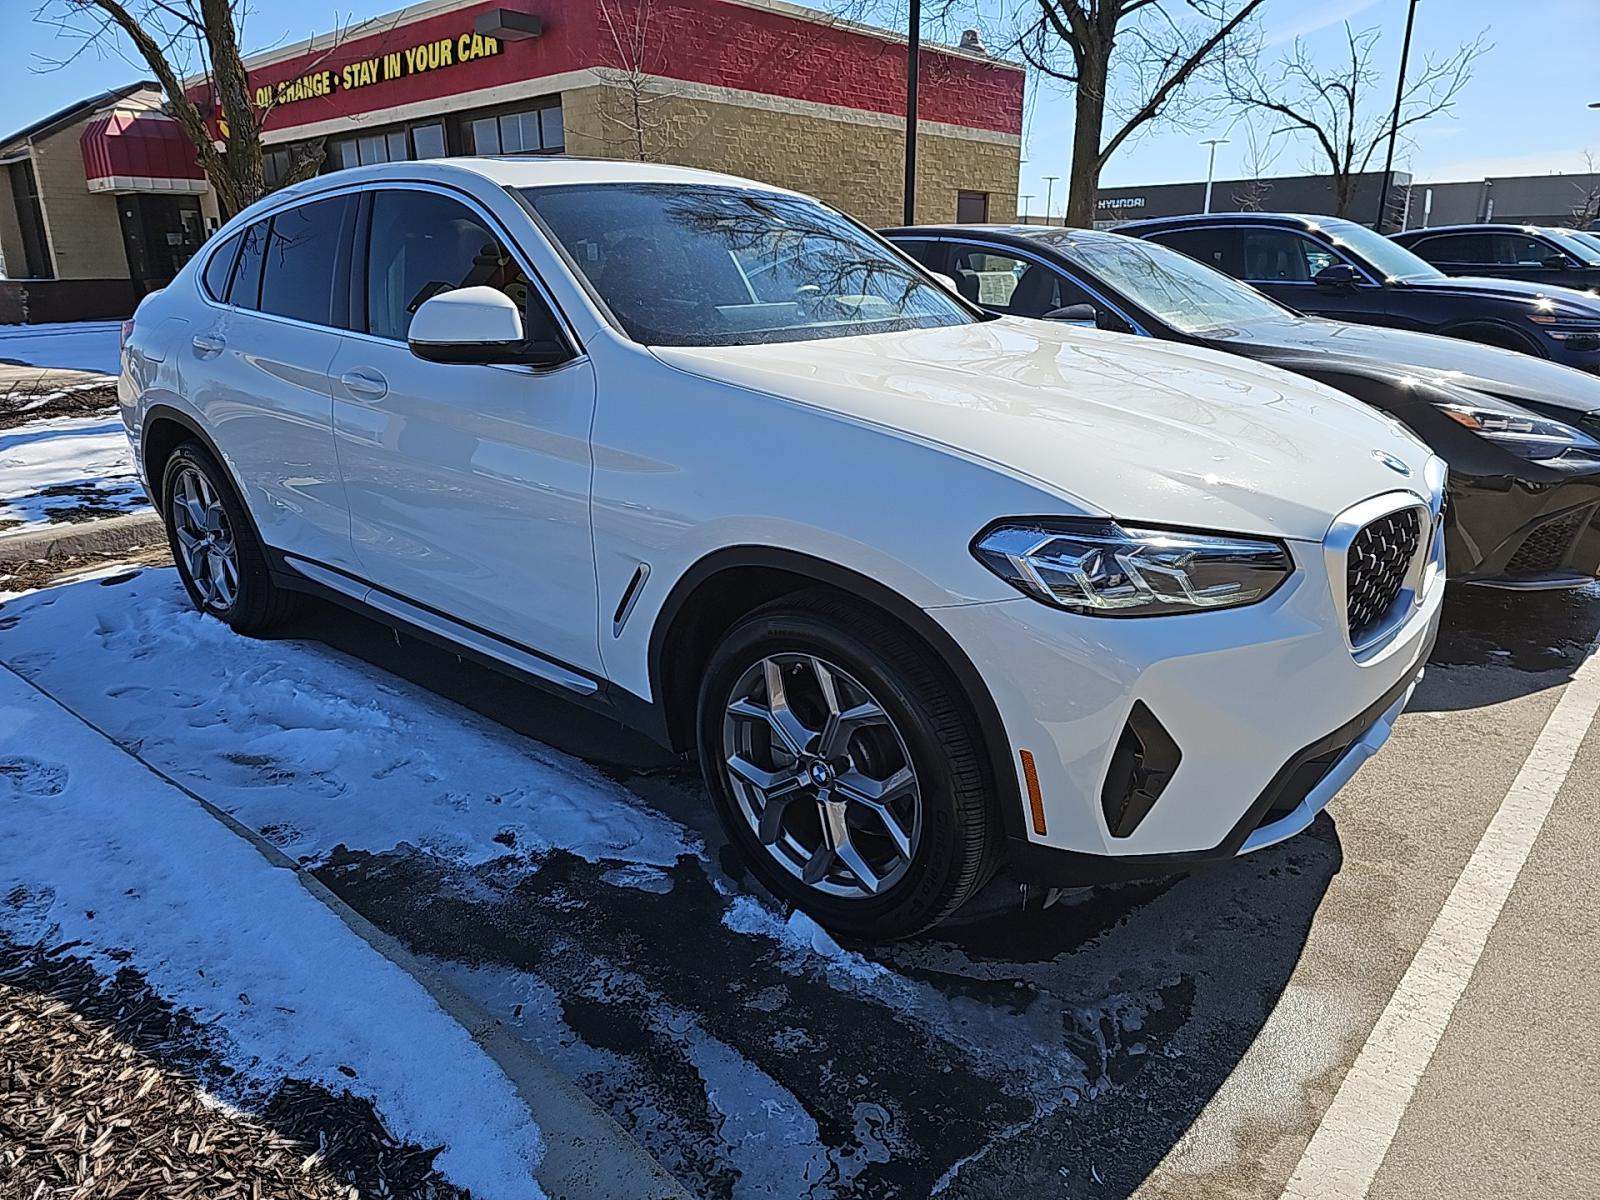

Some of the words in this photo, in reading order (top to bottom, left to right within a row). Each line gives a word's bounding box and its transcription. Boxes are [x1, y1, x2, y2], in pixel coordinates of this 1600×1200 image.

[277, 70, 331, 104] CHANGE
[342, 57, 380, 90] STAY
[383, 52, 401, 80] IN
[406, 37, 452, 74] YOUR
[457, 31, 498, 63] CAR
[1098, 197, 1145, 209] HYUNDAI
